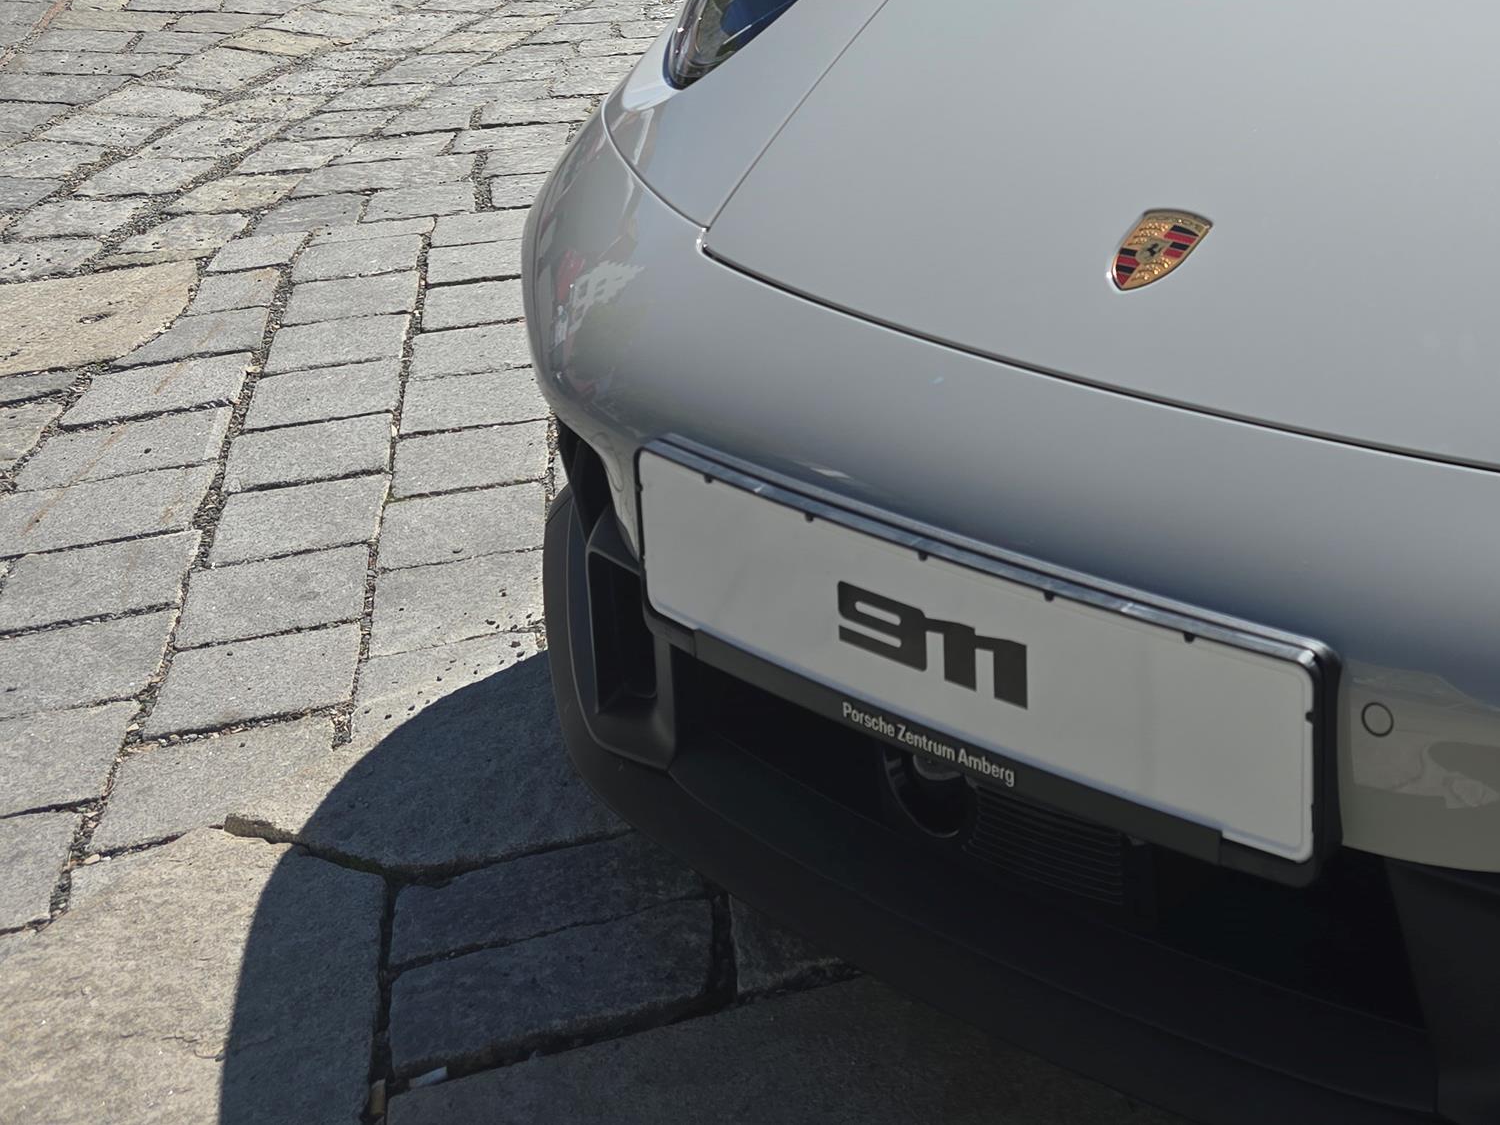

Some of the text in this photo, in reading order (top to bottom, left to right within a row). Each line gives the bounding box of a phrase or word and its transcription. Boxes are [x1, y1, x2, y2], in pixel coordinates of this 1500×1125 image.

[837, 580, 1029, 711] 911
[842, 701, 1015, 787] Porsche Zentrum Amberg
